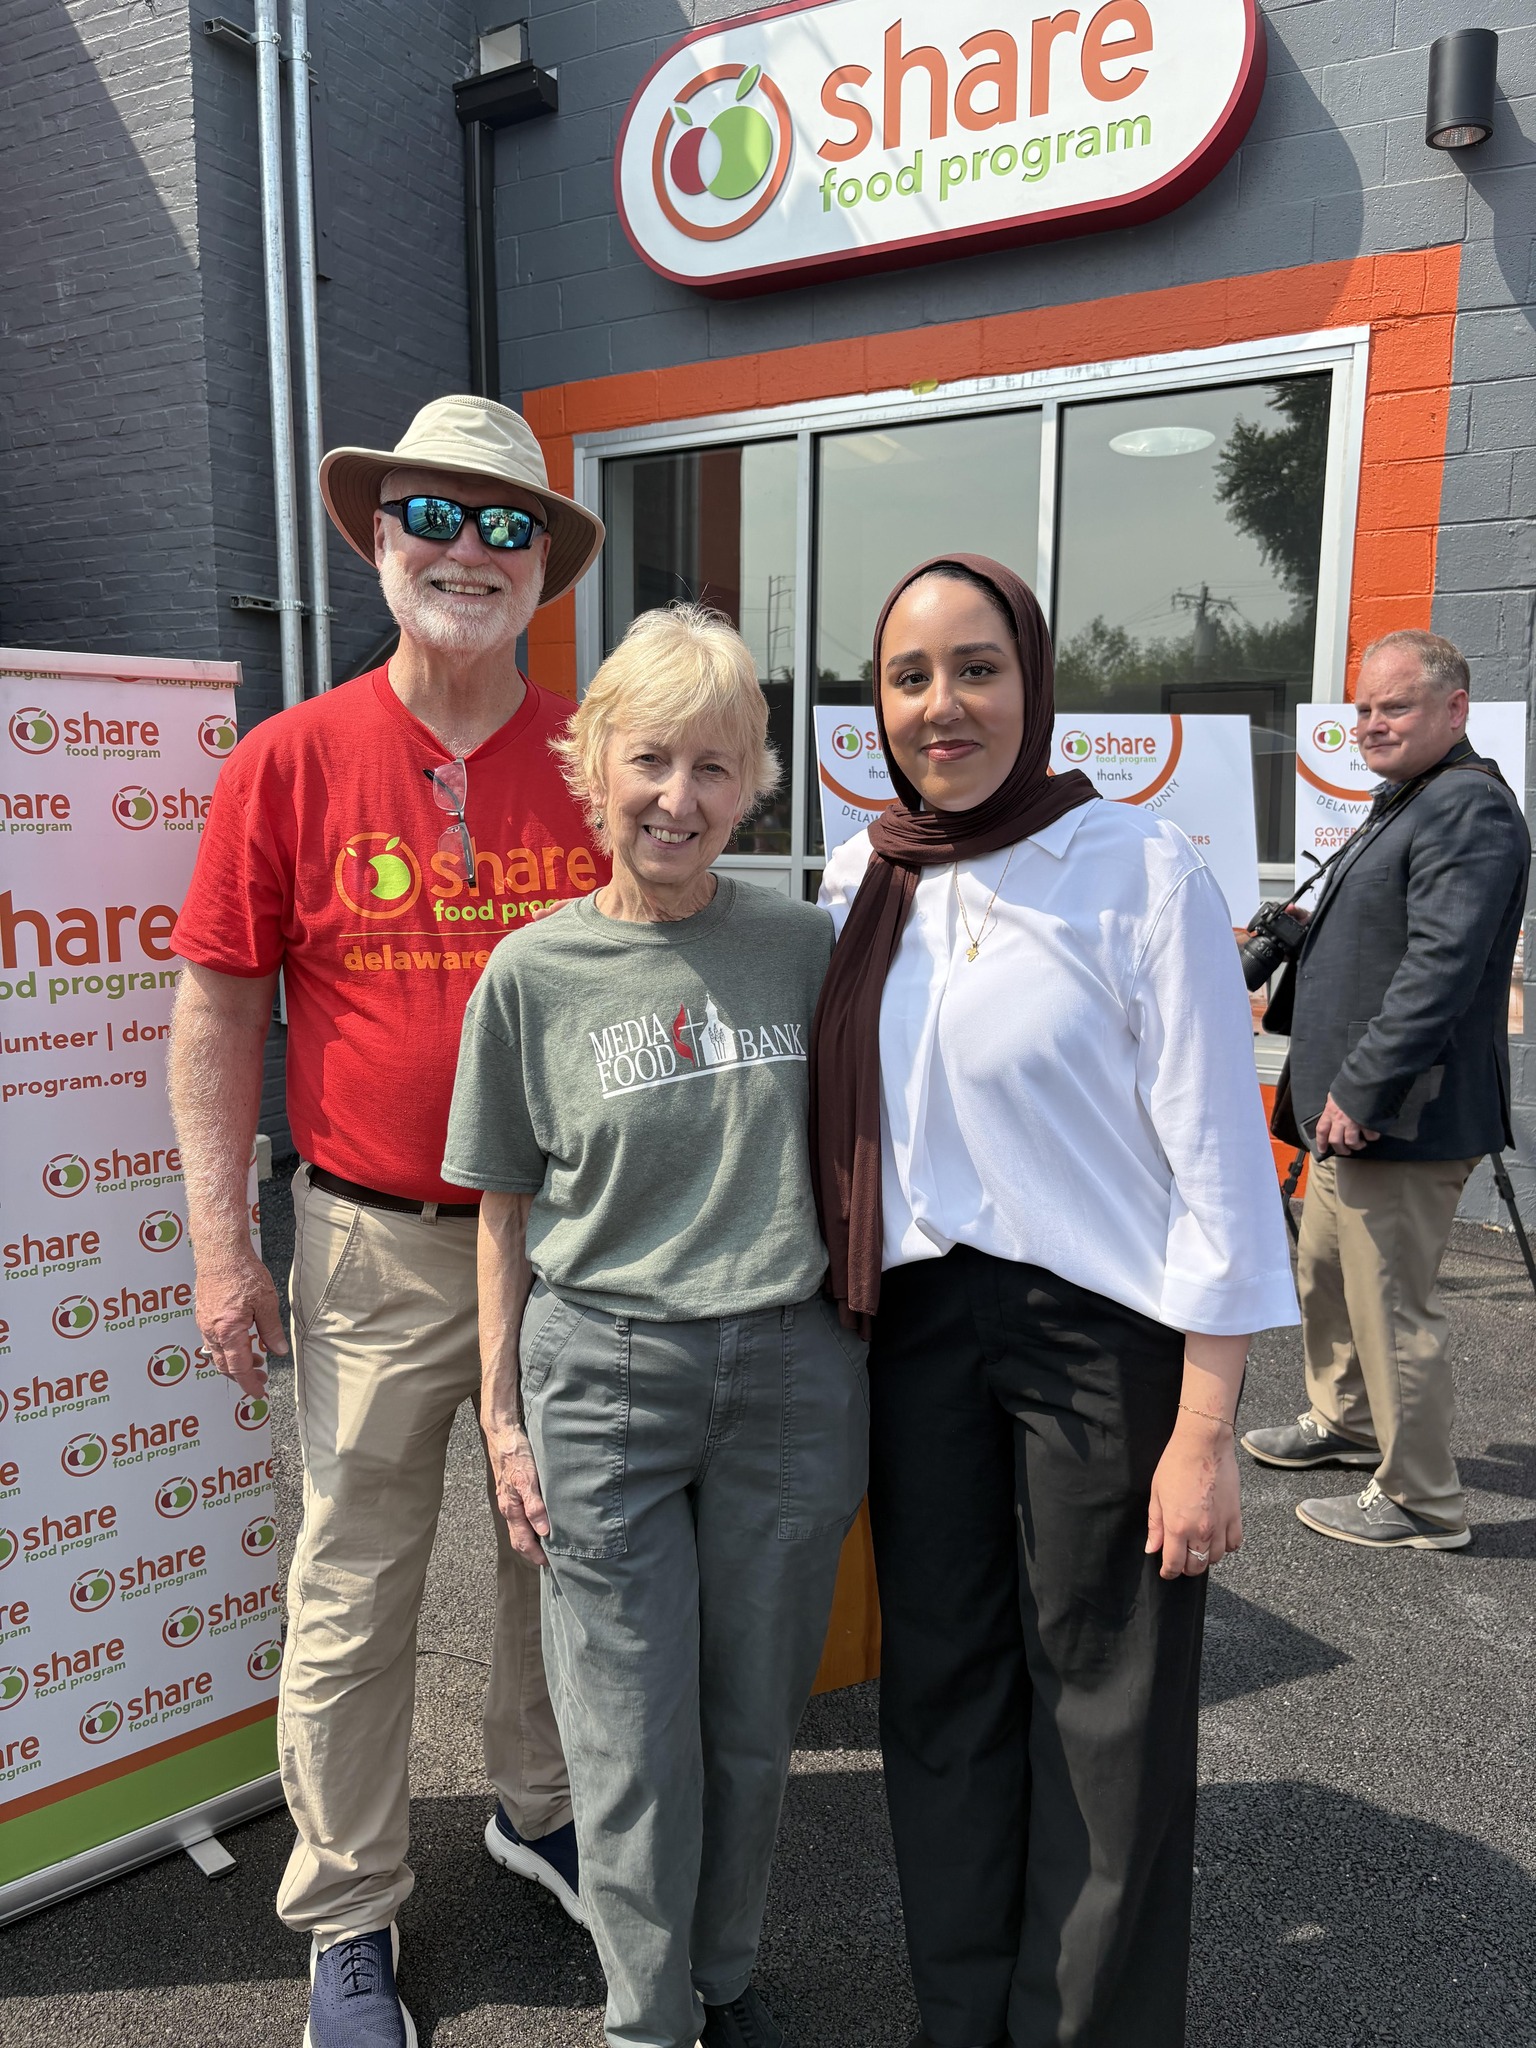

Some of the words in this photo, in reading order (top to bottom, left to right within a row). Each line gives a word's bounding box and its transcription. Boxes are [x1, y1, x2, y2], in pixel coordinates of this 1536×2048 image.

[816, 0, 1154, 163] share
[819, 150, 924, 213] food
[939, 114, 1152, 202] program
[64, 712, 159, 746] share
[1095, 732, 1156, 755] share
[65, 744, 98, 756] food
[103, 749, 160, 760] program
[1096, 755, 1116, 763] food
[1119, 756, 1157, 765] program
[1350, 759, 1368, 771] tha
[1097, 769, 1133, 781] thanks
[163, 788, 212, 819] sha
[1144, 779, 1180, 811] OUNTY
[1316, 795, 1369, 814] DELAWA
[11, 824, 72, 834] program
[164, 820, 193, 830] food
[1314, 838, 1348, 847] PART
[430, 836, 598, 898] share
[433, 898, 494, 922] food
[0, 890, 180, 969] hare
[343, 944, 489, 971] delaware
[0, 972, 37, 999] od
[49, 970, 181, 1004] program
[122, 1021, 171, 1043] don
[589, 1012, 671, 1063] MEDIA
[597, 1044, 677, 1093] FOOD
[737, 1023, 806, 1061] BANK
[2, 1070, 147, 1101] program.org
[95, 1149, 181, 1181] share
[96, 1180, 126, 1192] food
[4, 1231, 99, 1268] share
[5, 1267, 38, 1279] food
[43, 1257, 101, 1275] program
[104, 1284, 191, 1320] share
[105, 1318, 135, 1331] food
[139, 1308, 192, 1328] program
[14, 1370, 108, 1410] share
[15, 1409, 47, 1423] food
[52, 1395, 109, 1416] program
[112, 1415, 199, 1456] share
[113, 1453, 143, 1468] food
[147, 1440, 200, 1461] program
[203, 1494, 230, 1508] food
[234, 1482, 274, 1503] progra
[23, 1506, 116, 1551] share
[24, 1546, 56, 1561] food
[61, 1530, 117, 1555] program
[120, 1546, 205, 1590] share
[121, 1585, 150, 1600] food
[155, 1569, 206, 1592] program
[209, 1621, 236, 1635] food
[240, 1605, 281, 1628] progra
[33, 1638, 124, 1687] share
[35, 1681, 66, 1697] food
[70, 1661, 126, 1690] program
[128, 1672, 212, 1720] share
[129, 1714, 158, 1730] food
[162, 1696, 213, 1721] program
[0, 1760, 41, 1781] ogram
